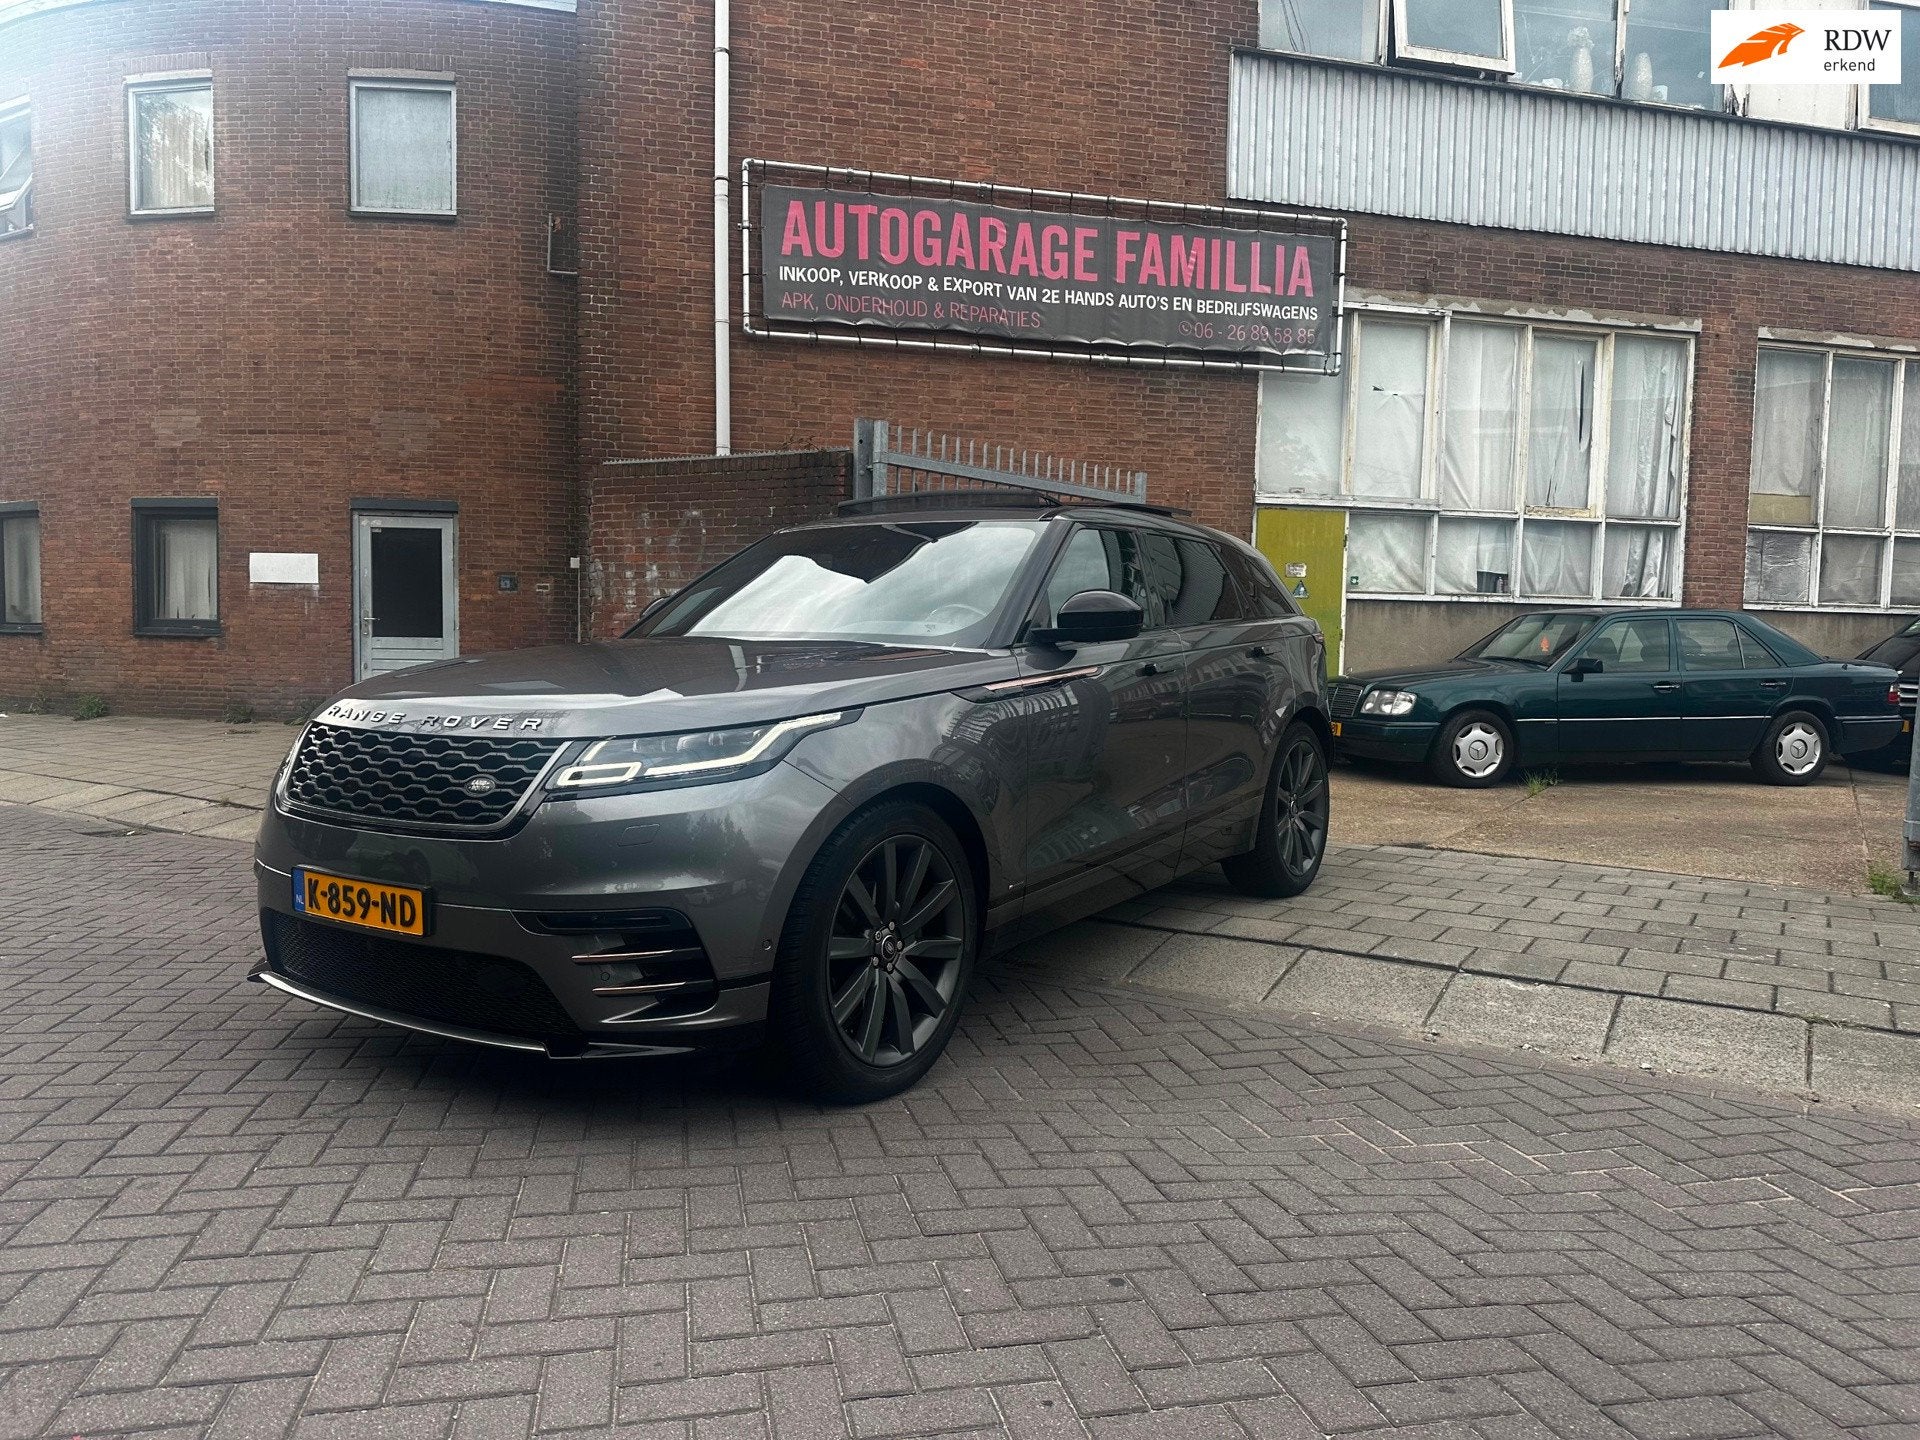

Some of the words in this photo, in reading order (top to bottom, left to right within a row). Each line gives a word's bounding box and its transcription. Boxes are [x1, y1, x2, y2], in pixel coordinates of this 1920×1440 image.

[780, 199, 1099, 282] AUTOGARAGE
[1115, 230, 1314, 298] FAMILLIA
[778, 265, 844, 287] INKOOP,
[848, 270, 923, 290] VERKOOP
[927, 276, 939, 292] &
[942, 276, 1003, 298] EXPORT
[1007, 285, 1037, 302] VAN
[1041, 288, 1061, 304] 2E
[1064, 290, 1115, 307] HANDS
[1118, 294, 1169, 311] AUTO'S
[1173, 296, 1193, 312] EN
[1196, 300, 1319, 321] BEDRIJFSWAGENS
[781, 291, 819, 313] APK,
[825, 292, 928, 317] ONDERHOUD
[933, 302, 945, 319] &
[949, 301, 1042, 328] REPARATIES
[1194, 321, 1214, 340] 06
[1227, 323, 1246, 341] 26
[1250, 324, 1269, 342] 89
[1274, 327, 1293, 344] 58
[1296, 327, 1316, 345] 85
[327, 705, 407, 724] RANGE
[421, 714, 543, 731] ROVER
[307, 877, 417, 928] K-859-ND
